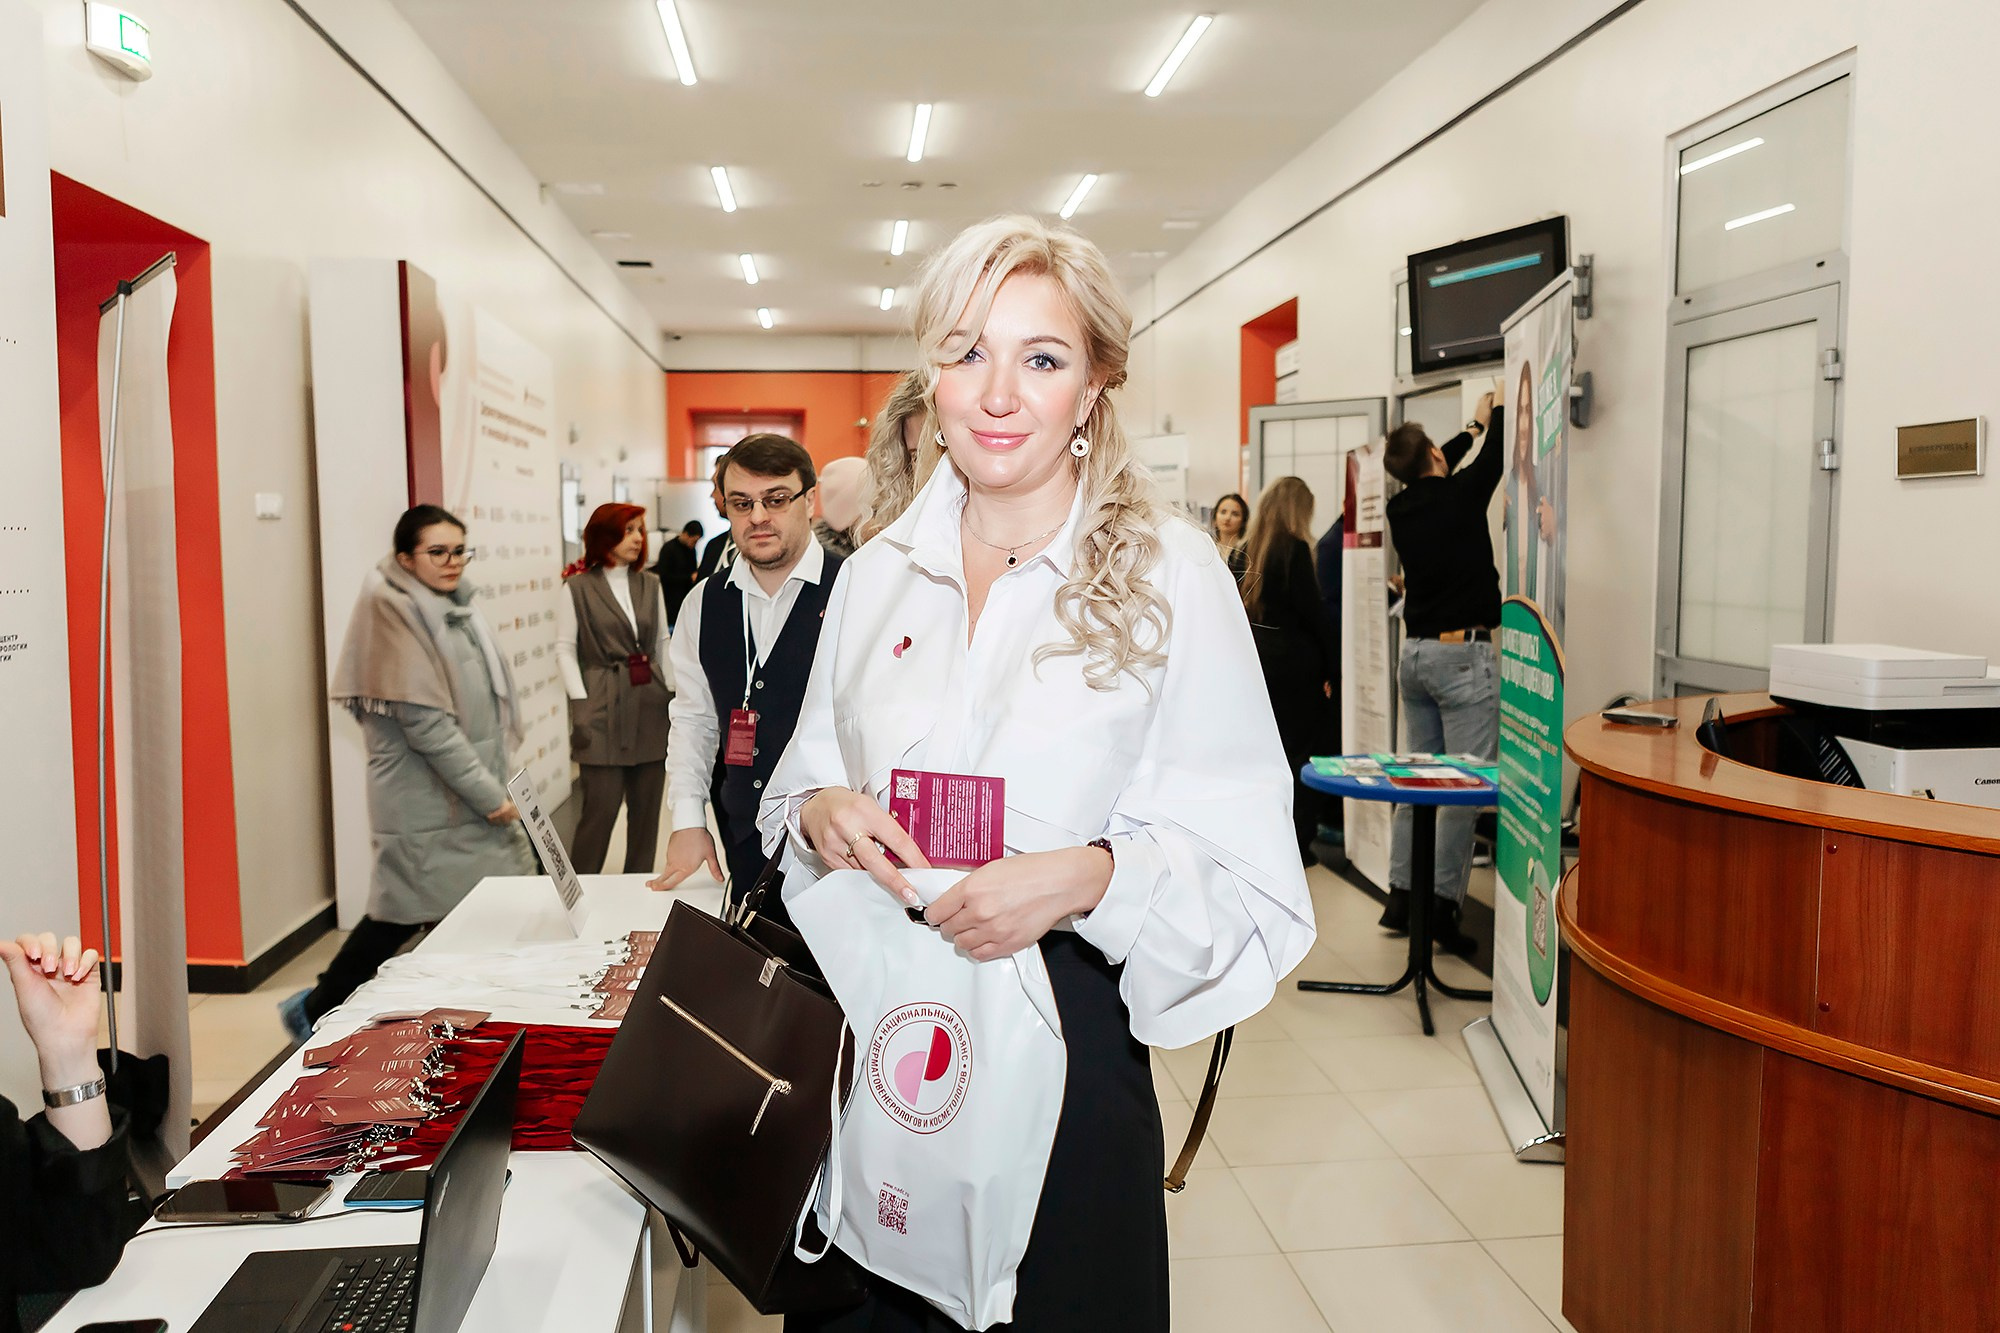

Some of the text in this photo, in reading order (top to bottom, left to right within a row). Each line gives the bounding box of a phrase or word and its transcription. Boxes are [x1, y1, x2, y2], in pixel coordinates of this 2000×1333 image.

[881, 1008, 968, 1061] НАЦИОНАЛЬНЫЙ АЛЬЯНС
[871, 1040, 967, 1128] ДЕРМАТОВЕНЕРОЛОГОВ И КОСМЕТОЛОГОВ
